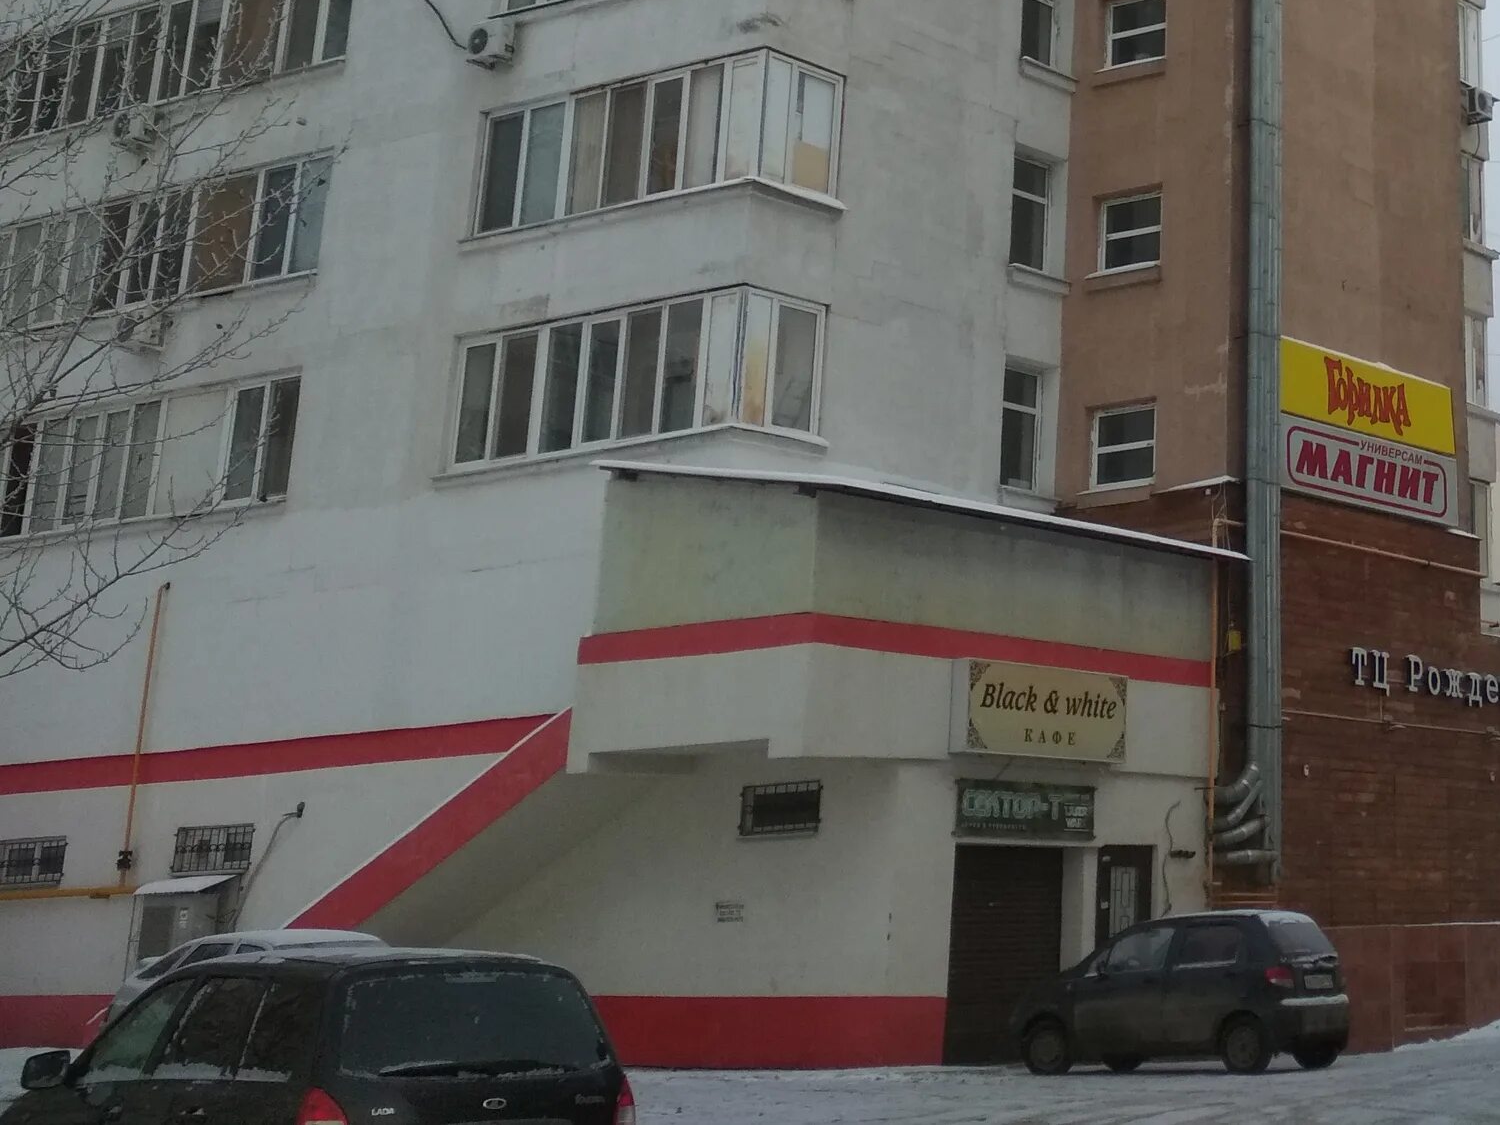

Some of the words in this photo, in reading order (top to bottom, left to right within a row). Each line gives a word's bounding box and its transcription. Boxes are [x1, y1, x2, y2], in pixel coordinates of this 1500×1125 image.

[1359, 440, 1423, 465] УНИВЕРСАМ
[1296, 440, 1439, 504] МАГНИТ
[1351, 647, 1390, 696] ТЦ
[981, 683, 1037, 713] Black
[1044, 690, 1059, 714] &
[1065, 691, 1117, 720] white
[1024, 729, 1076, 745] КАФЕ
[371, 1107, 395, 1116] LADA
